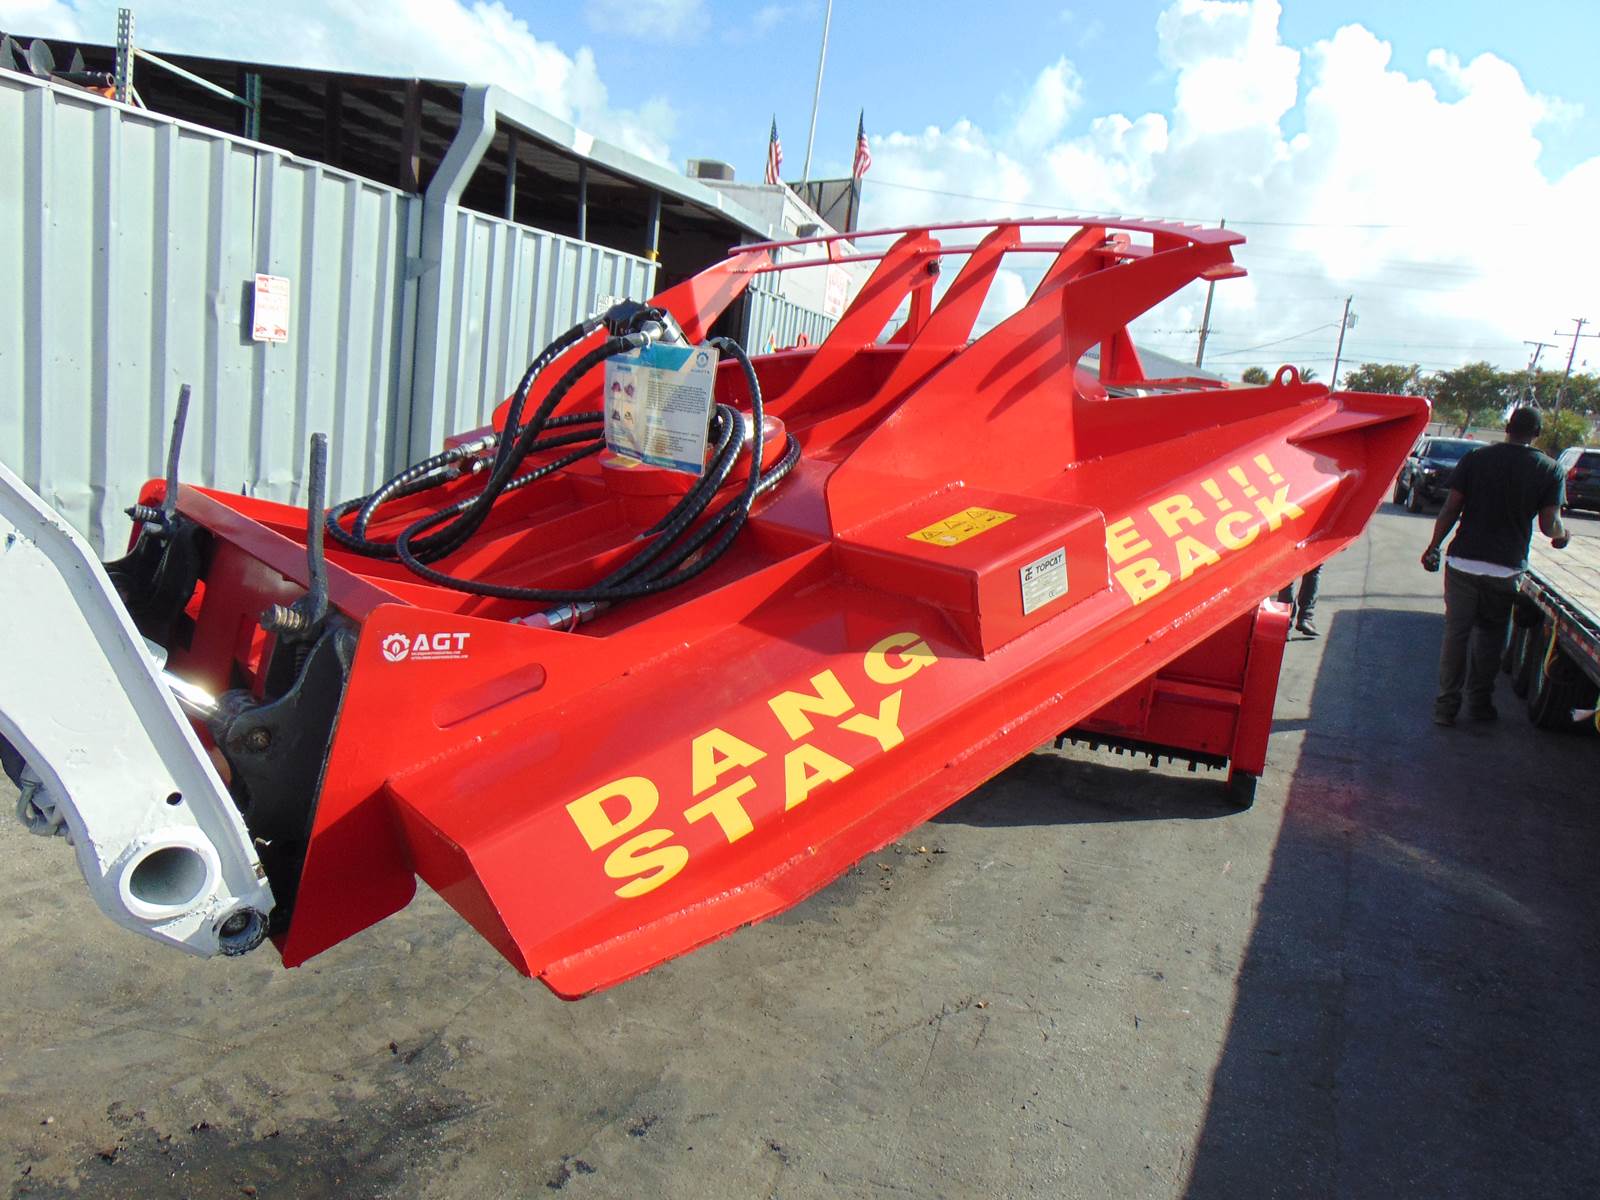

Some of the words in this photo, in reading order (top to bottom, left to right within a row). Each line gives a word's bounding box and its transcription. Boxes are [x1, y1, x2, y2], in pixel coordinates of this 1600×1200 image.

[1035, 554, 1062, 574] TOPCAT
[413, 632, 471, 651] AGT
[604, 689, 905, 898] STAY
[1114, 484, 1305, 606] BACK
